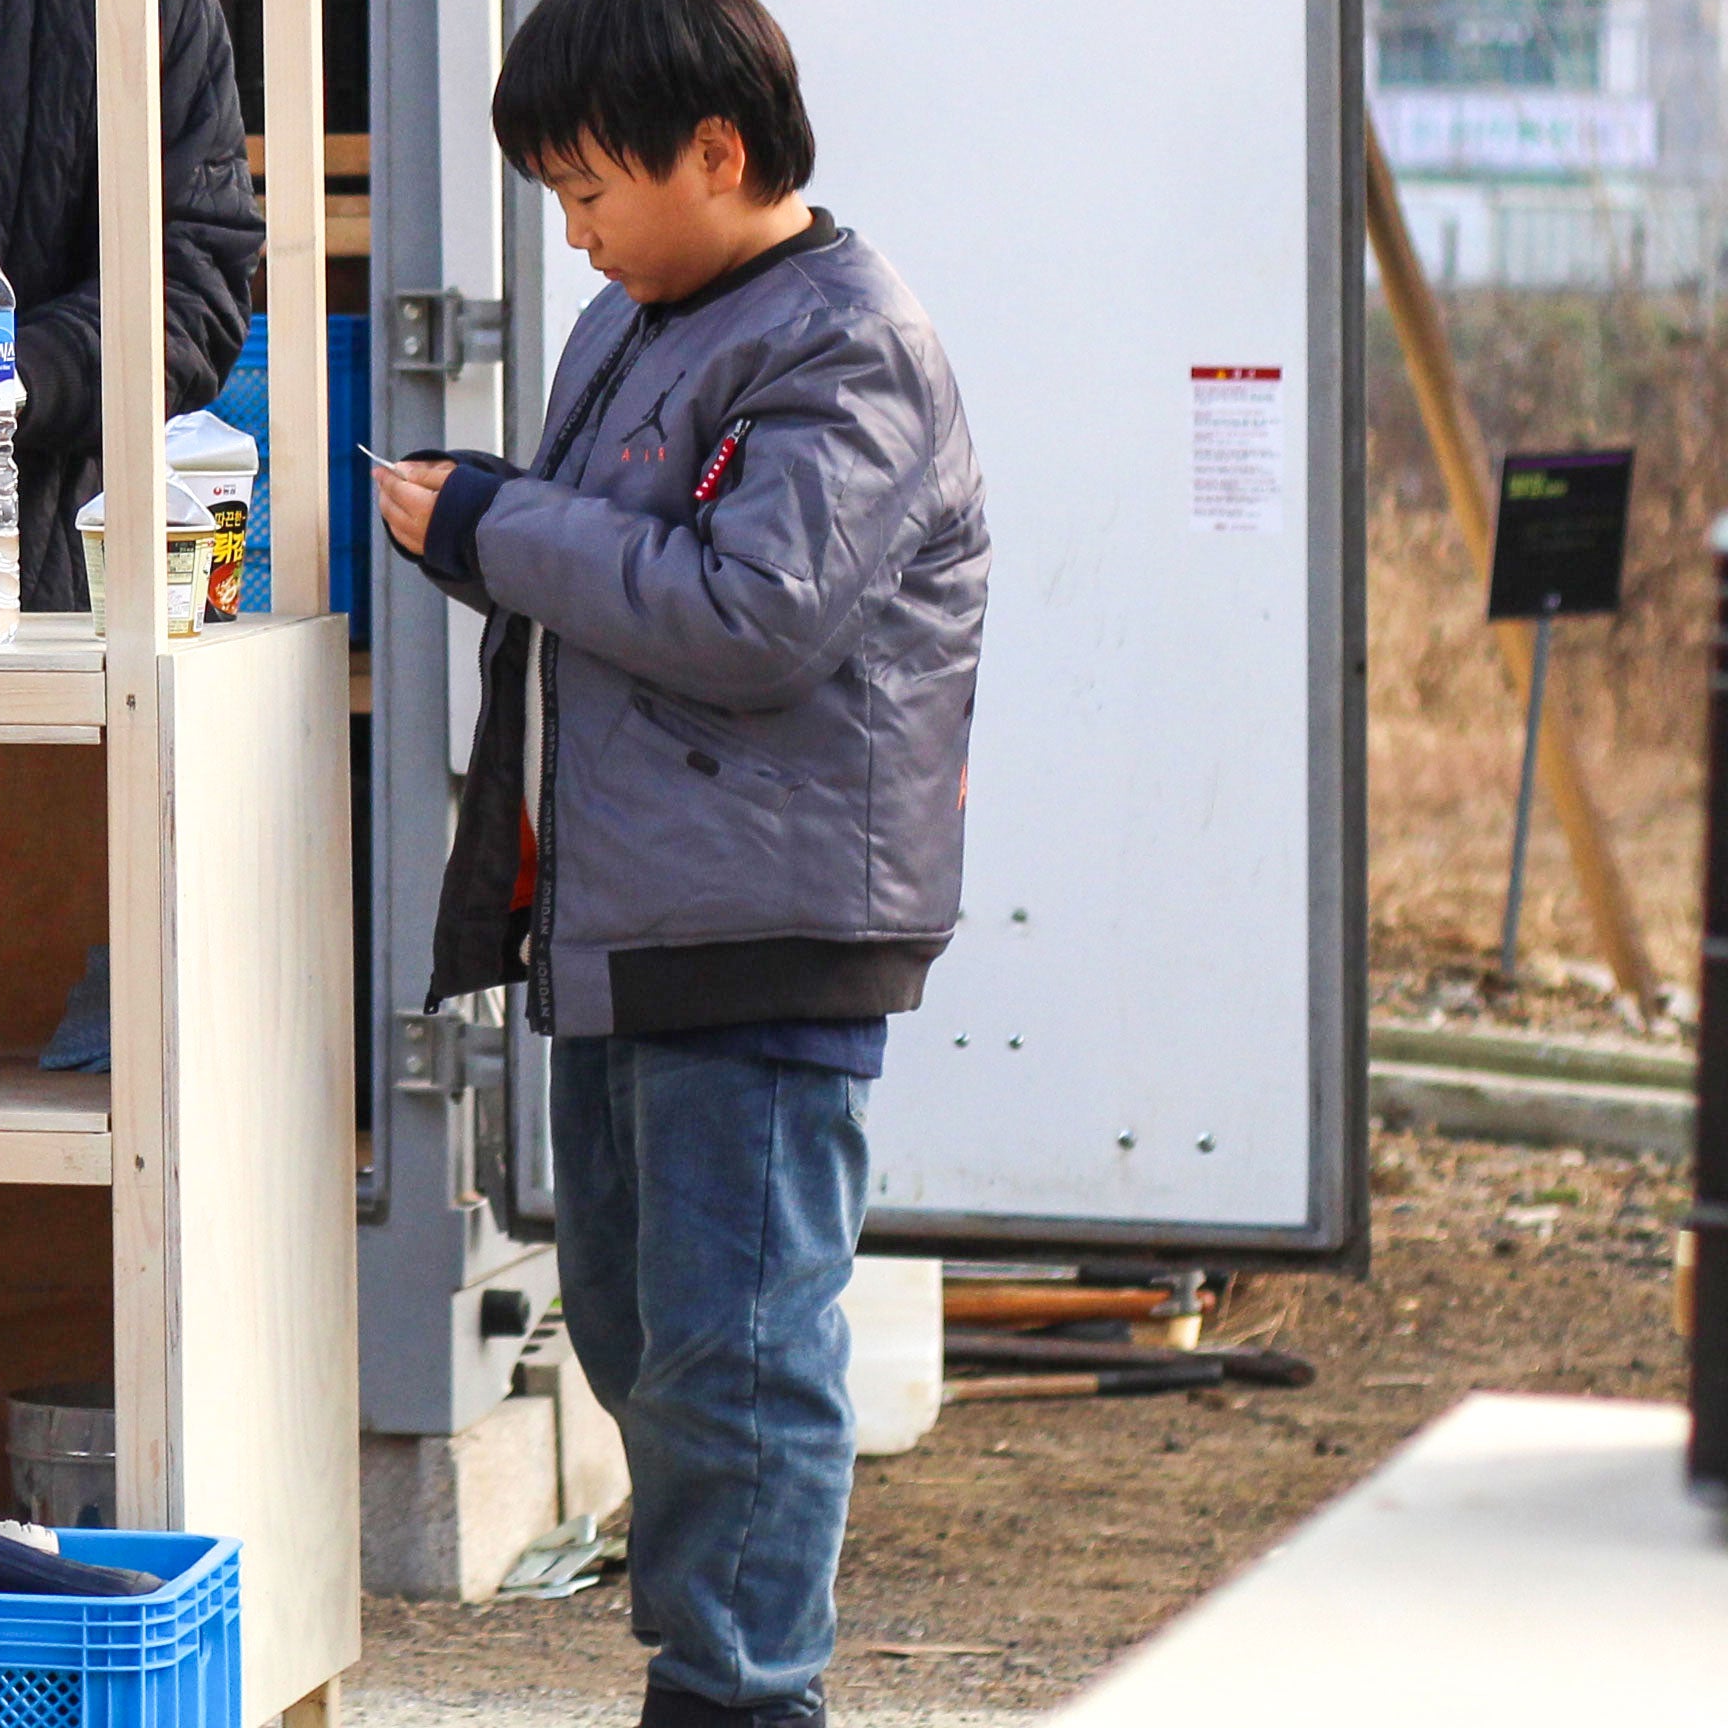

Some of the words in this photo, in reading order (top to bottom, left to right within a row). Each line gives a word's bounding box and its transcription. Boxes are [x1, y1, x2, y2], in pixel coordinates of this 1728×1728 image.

[620, 446, 667, 463] AIR
[541, 879, 553, 935] JORDAN
[537, 960, 551, 1017] JORDAN
